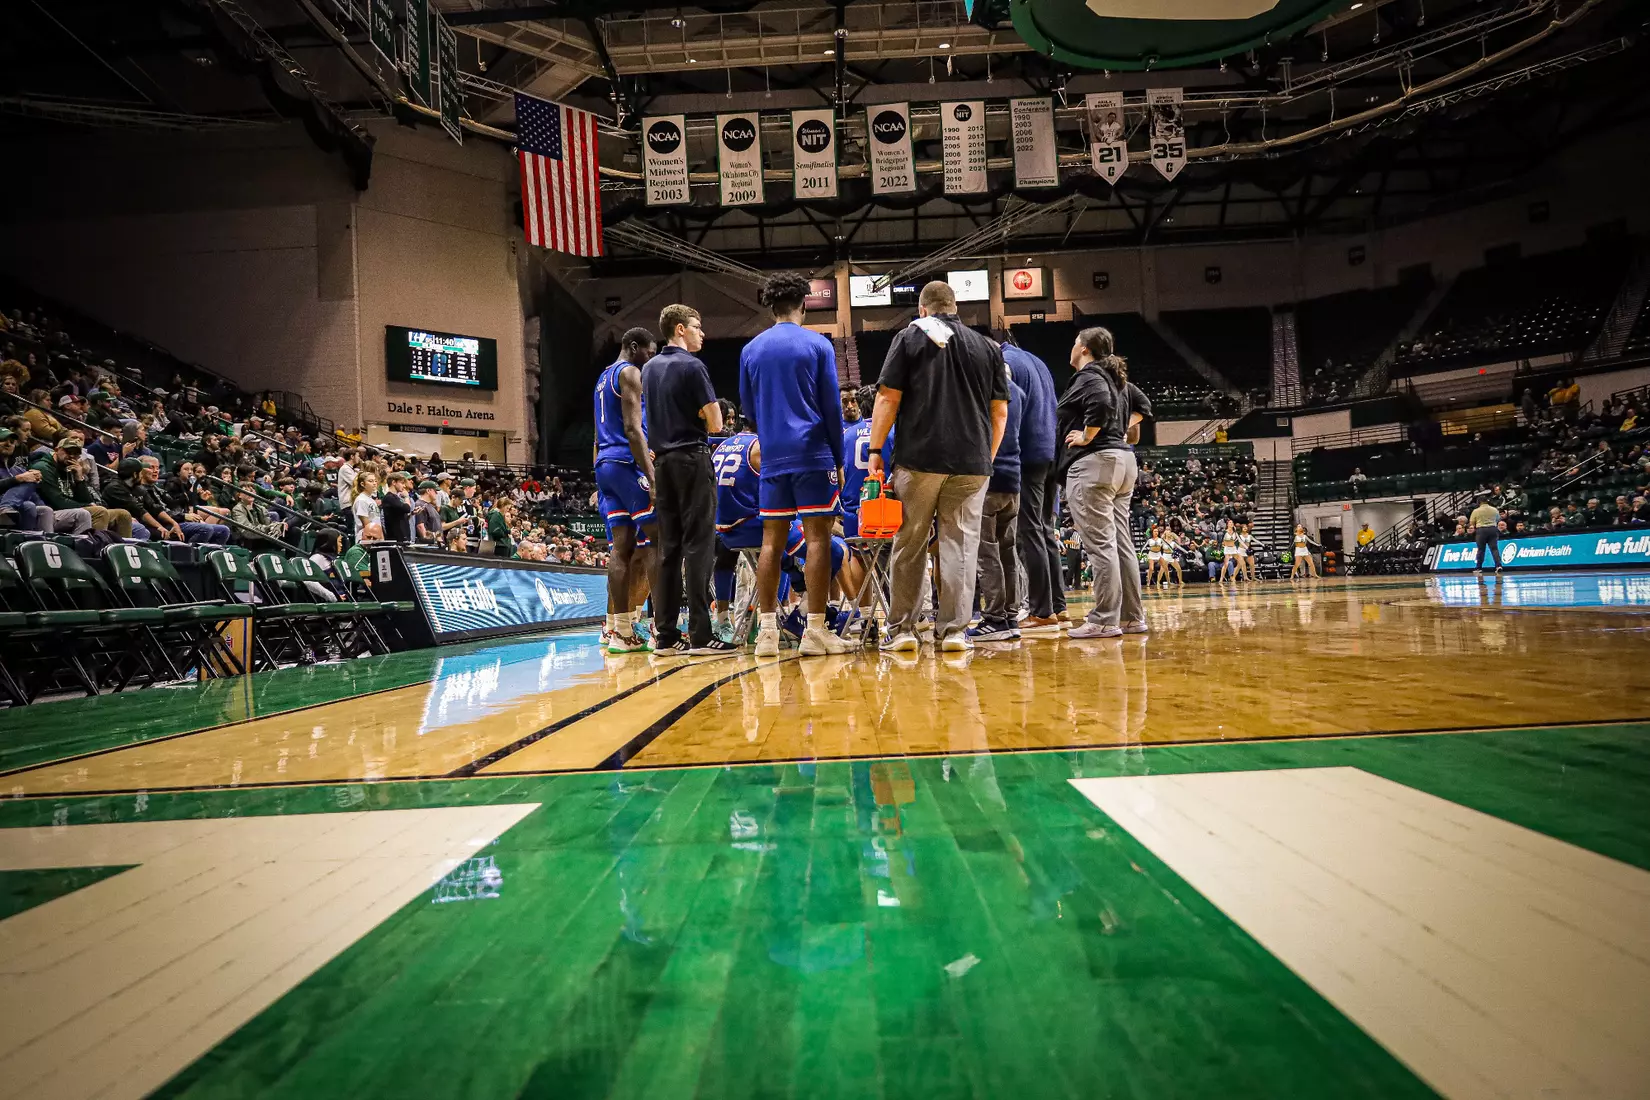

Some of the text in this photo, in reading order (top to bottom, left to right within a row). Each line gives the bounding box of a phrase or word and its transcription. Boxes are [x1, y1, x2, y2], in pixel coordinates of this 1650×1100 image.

[375, 13, 390, 42] 1976
[874, 122, 904, 132] NCAA
[649, 132, 679, 142] NCAA
[724, 129, 754, 139] NCAA
[802, 134, 826, 145] NIT
[1099, 146, 1122, 163] 21
[1153, 143, 1183, 159] 35
[649, 157, 684, 166] Women's
[796, 161, 834, 170] Semifinalist
[875, 157, 908, 165] Bridgeport
[649, 168, 684, 176] Midwest
[749, 170, 759, 178] City
[649, 178, 686, 187] Regional
[731, 180, 753, 188] Regional
[802, 177, 829, 188] 2011
[880, 175, 908, 187] 2022
[654, 189, 683, 200] 2003
[728, 190, 756, 202] 2009
[435, 337, 454, 345] 11:40
[387, 402, 495, 420] Dale F. Halton Arena
[712, 453, 742, 486] 22
[1517, 545, 1572, 558] Atrium Health
[1595, 538, 1621, 555] live
[1443, 549, 1460, 562] live
[434, 578, 499, 616] live fully
